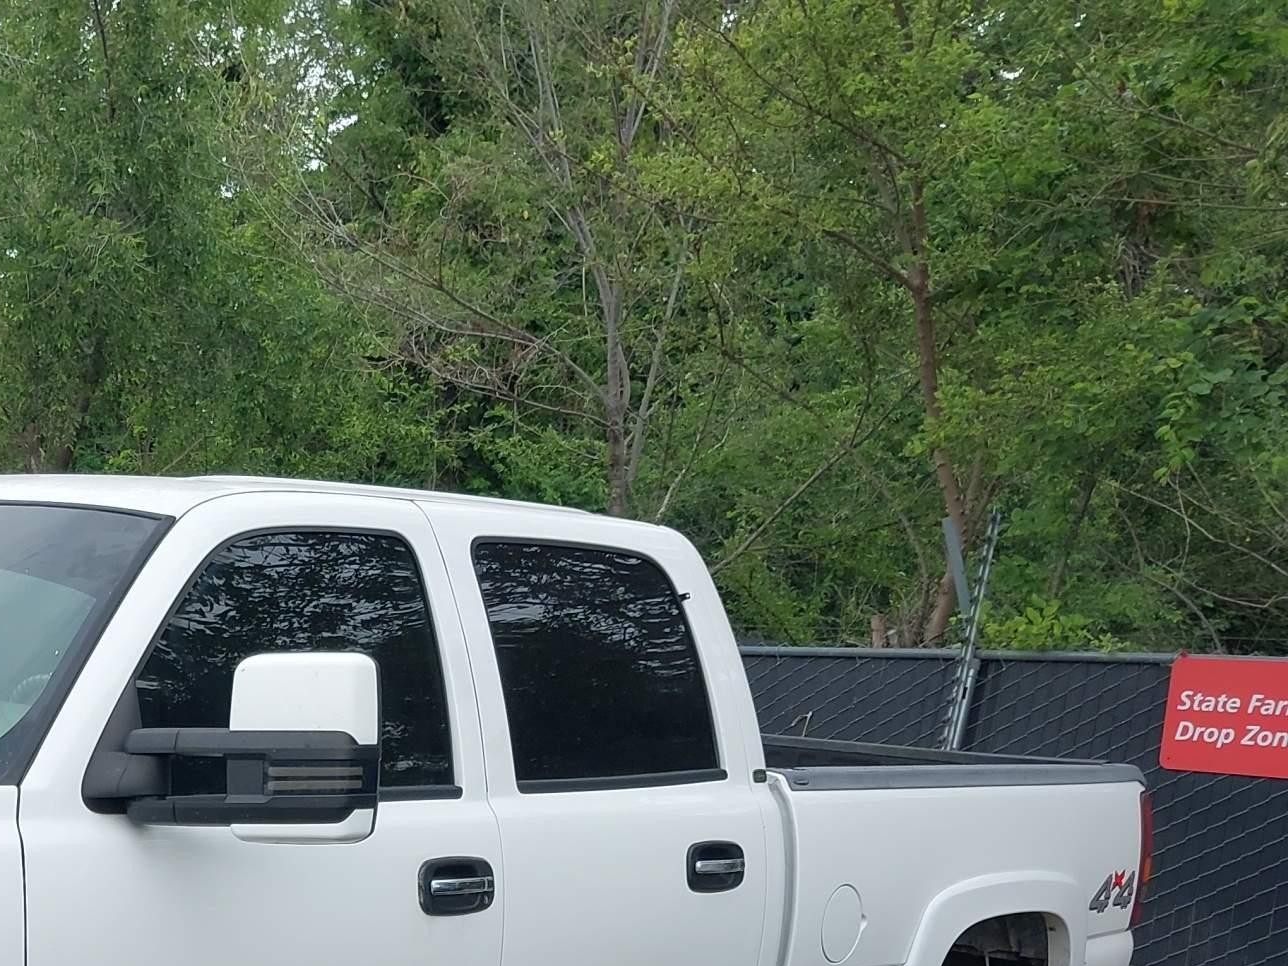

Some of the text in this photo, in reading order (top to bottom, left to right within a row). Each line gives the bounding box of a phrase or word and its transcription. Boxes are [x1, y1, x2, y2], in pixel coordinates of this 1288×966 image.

[1177, 690, 1288, 716] State Far
[1174, 721, 1235, 748] Drop
